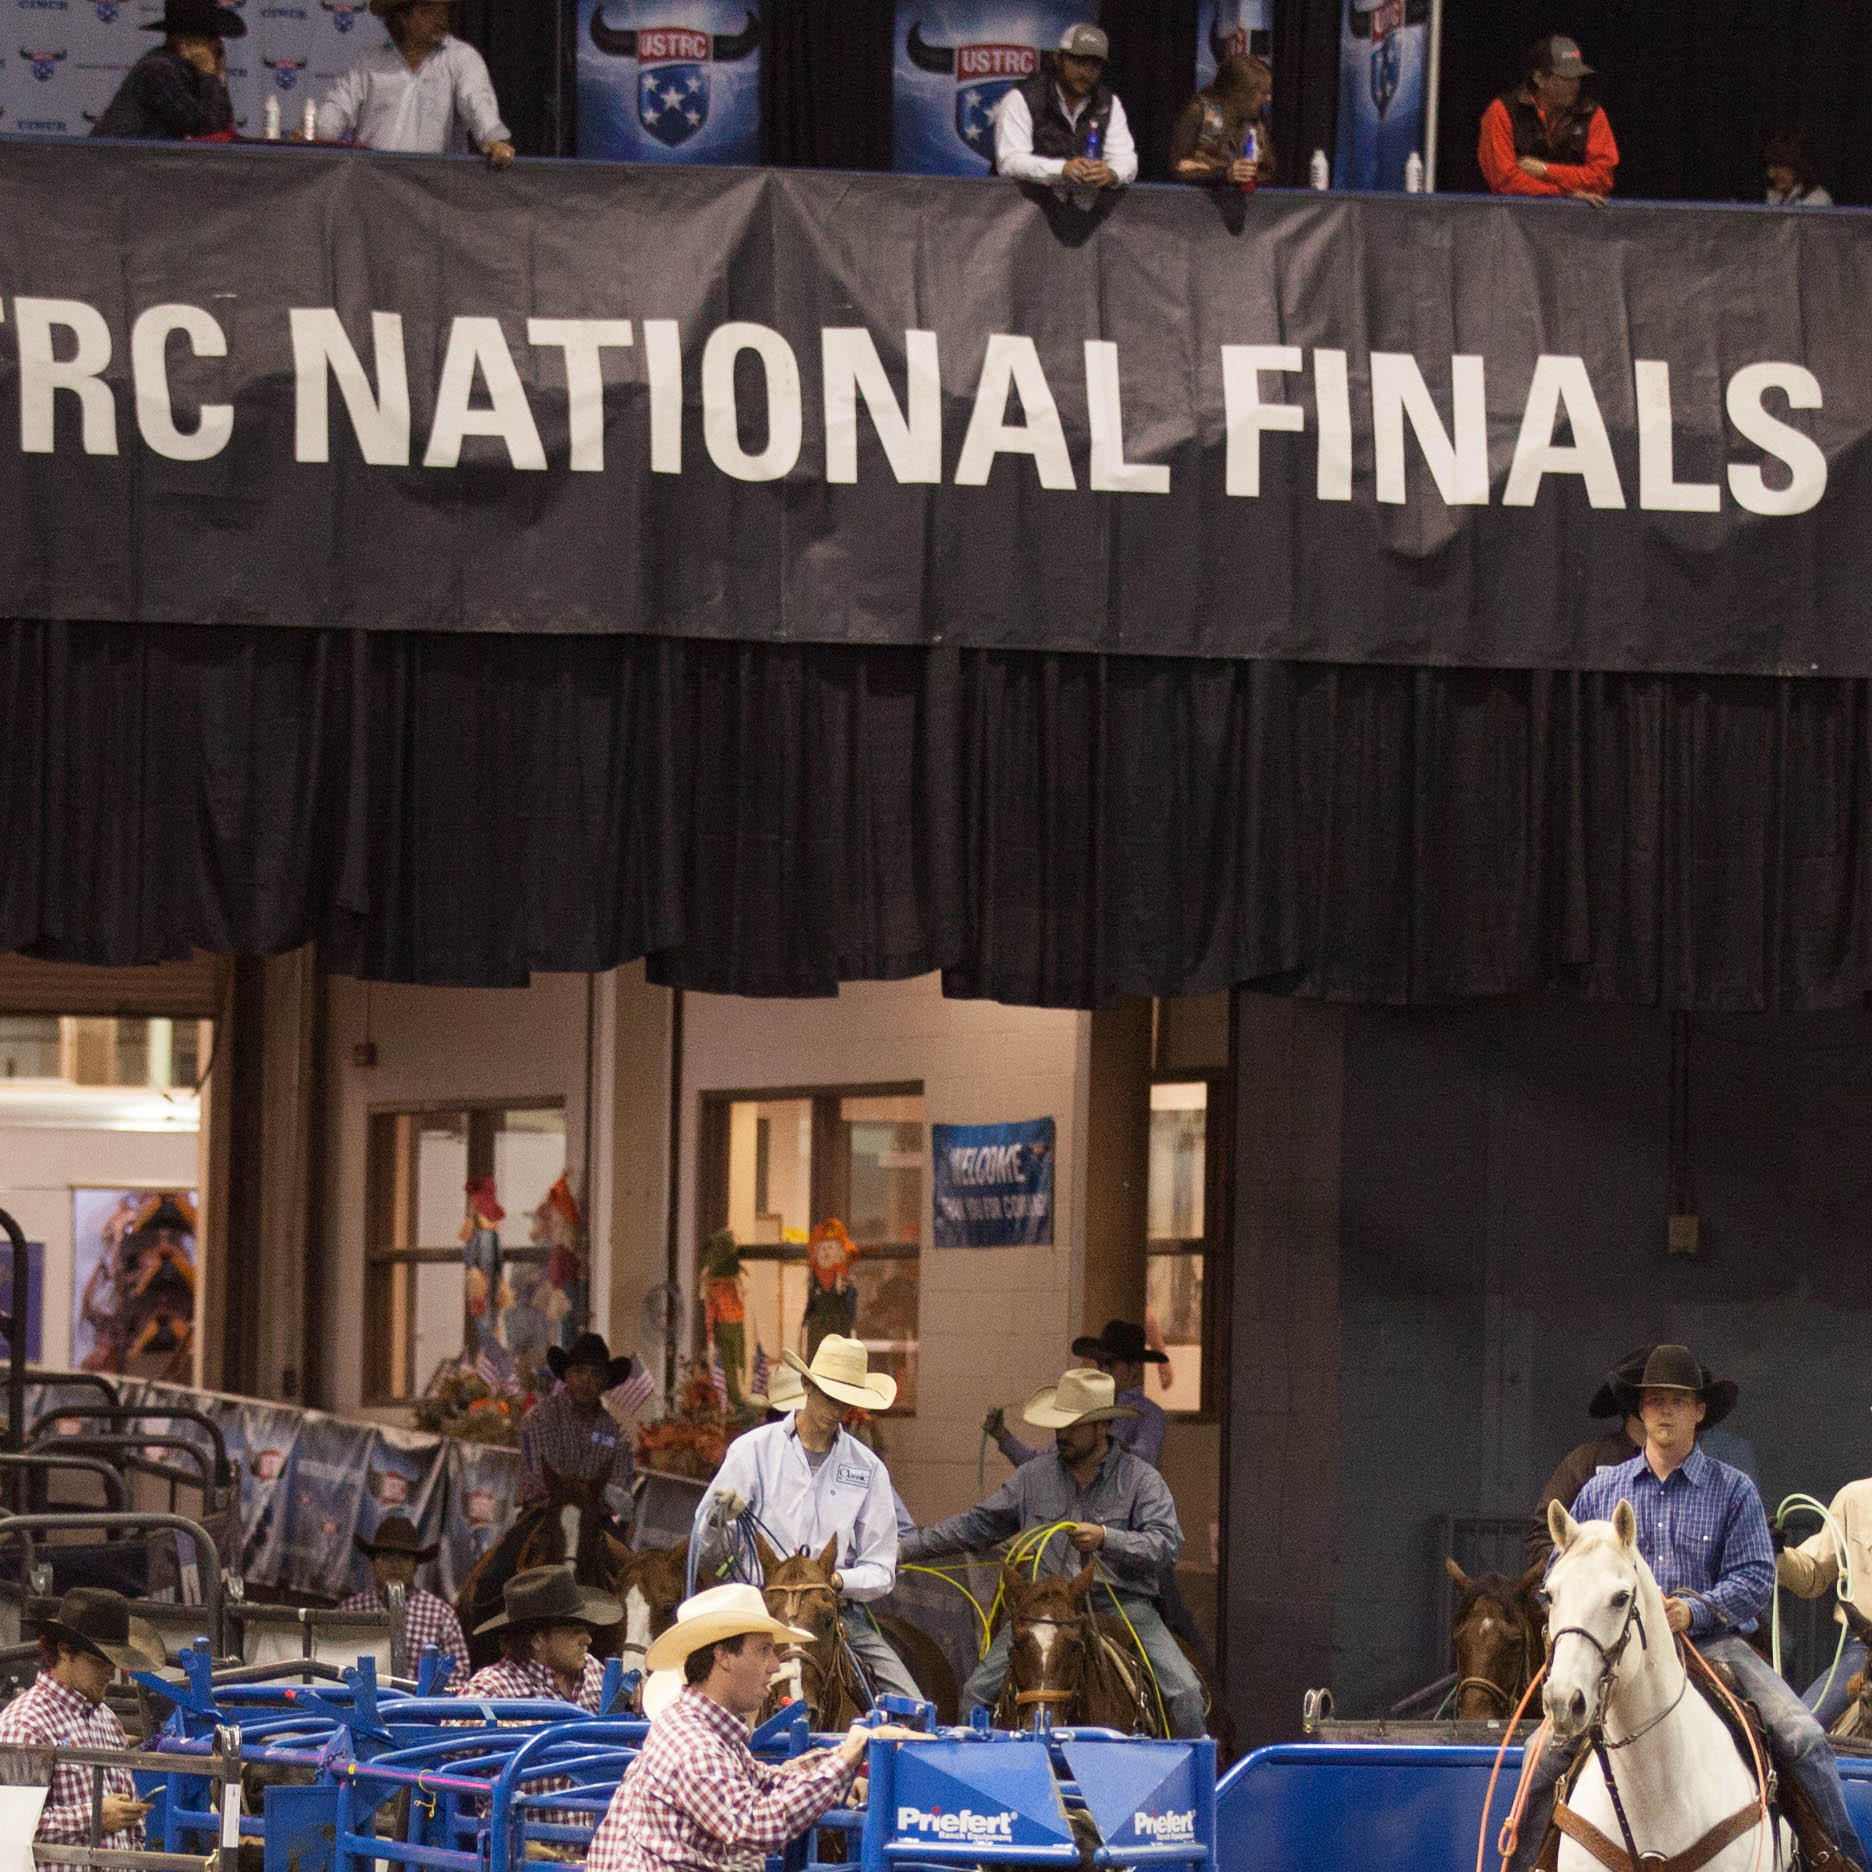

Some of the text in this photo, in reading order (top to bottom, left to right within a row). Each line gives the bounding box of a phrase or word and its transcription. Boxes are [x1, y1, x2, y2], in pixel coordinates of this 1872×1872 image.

[639, 31, 708, 61] USTRC
[961, 46, 1035, 76] USTRC
[290, 307, 1170, 494] NATIONAL
[1221, 345, 1828, 517] FINALS
[947, 1142, 1026, 1186] WELCOME
[897, 1805, 1012, 1835] Priefert
